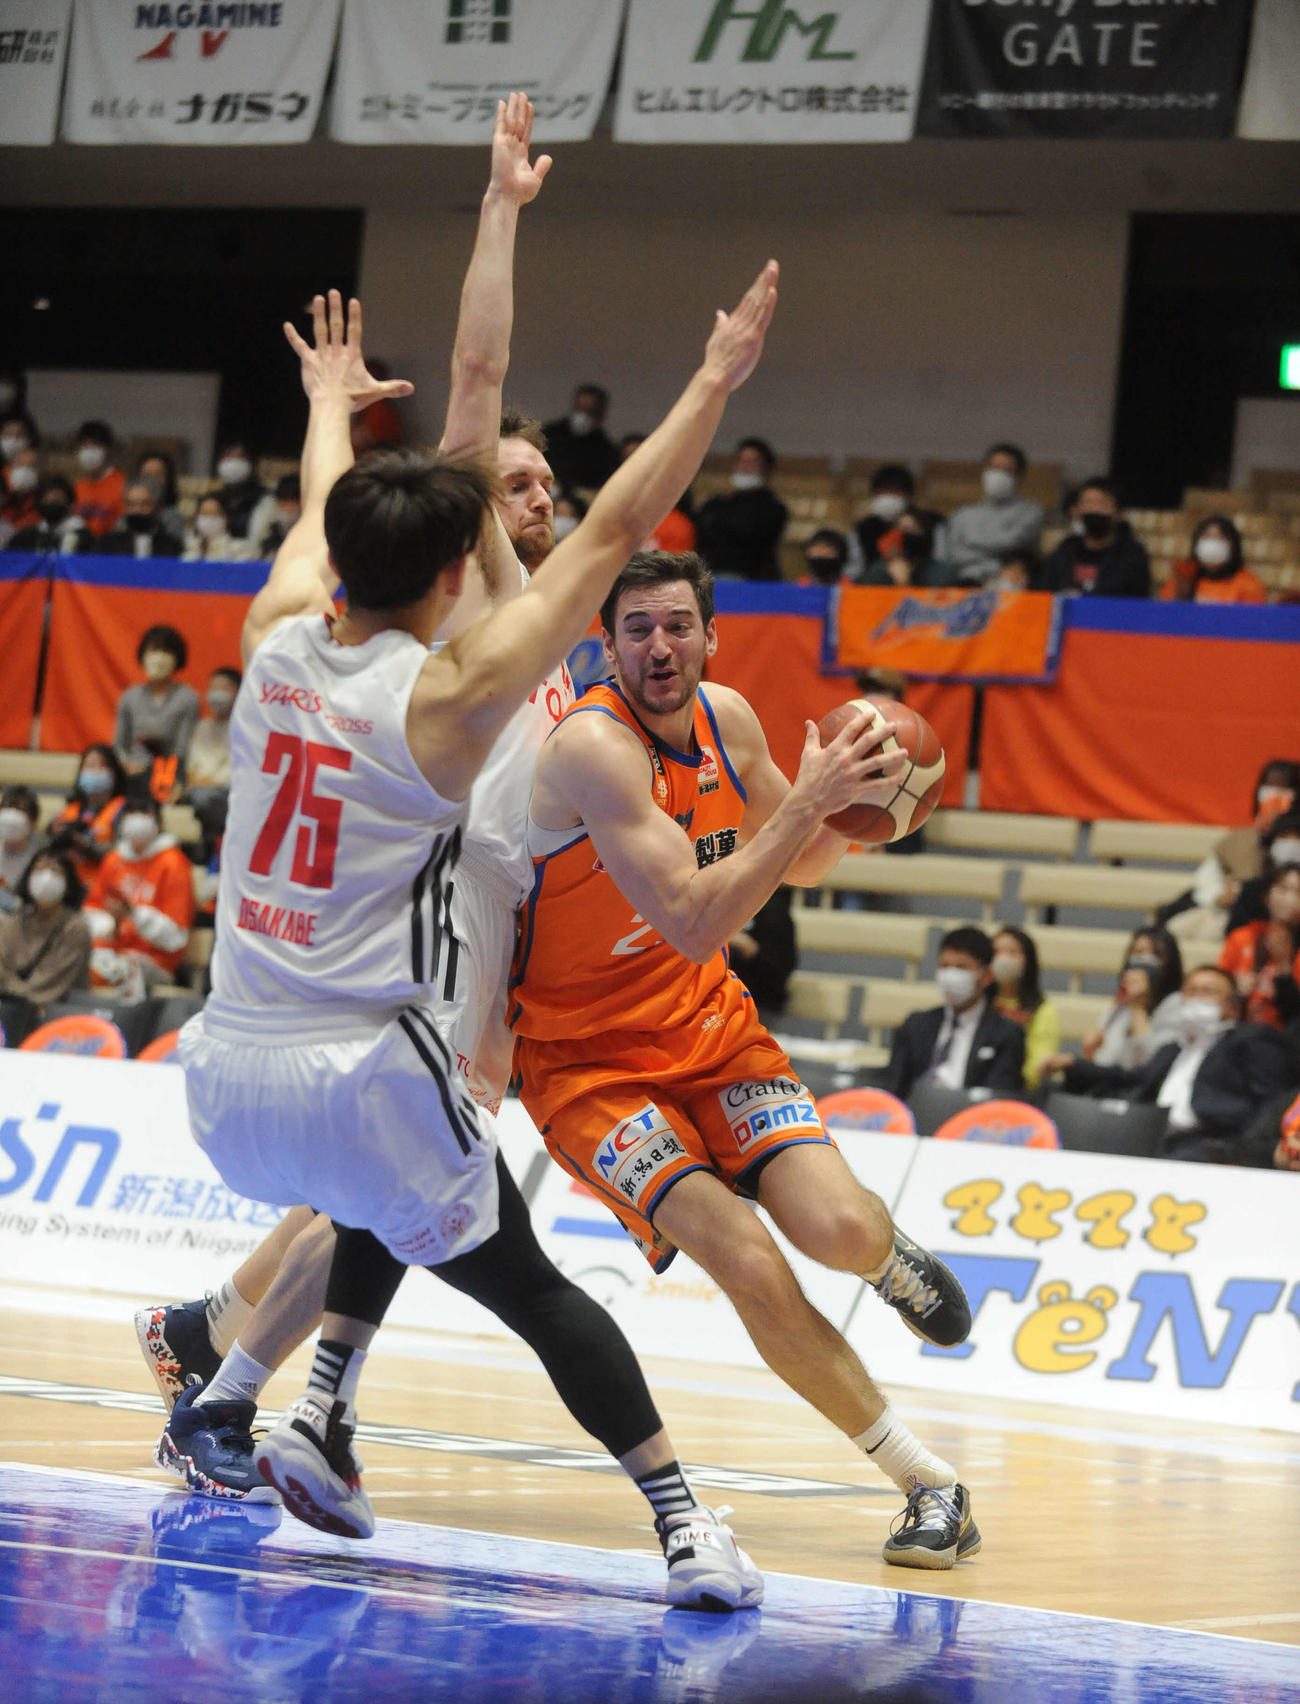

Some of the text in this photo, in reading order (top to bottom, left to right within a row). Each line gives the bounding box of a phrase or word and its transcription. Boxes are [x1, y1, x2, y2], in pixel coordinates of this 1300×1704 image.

[135, 2, 282, 28] NAGAMINE
[1003, 22, 1161, 67] GATE
[248, 731, 353, 890] 75
[237, 897, 318, 946] OSAKABE
[598, 1108, 655, 1178] NCT
[45, 1213, 142, 1245] System
[147, 1228, 174, 1246] of
[673, 1530, 712, 1546] TIME
